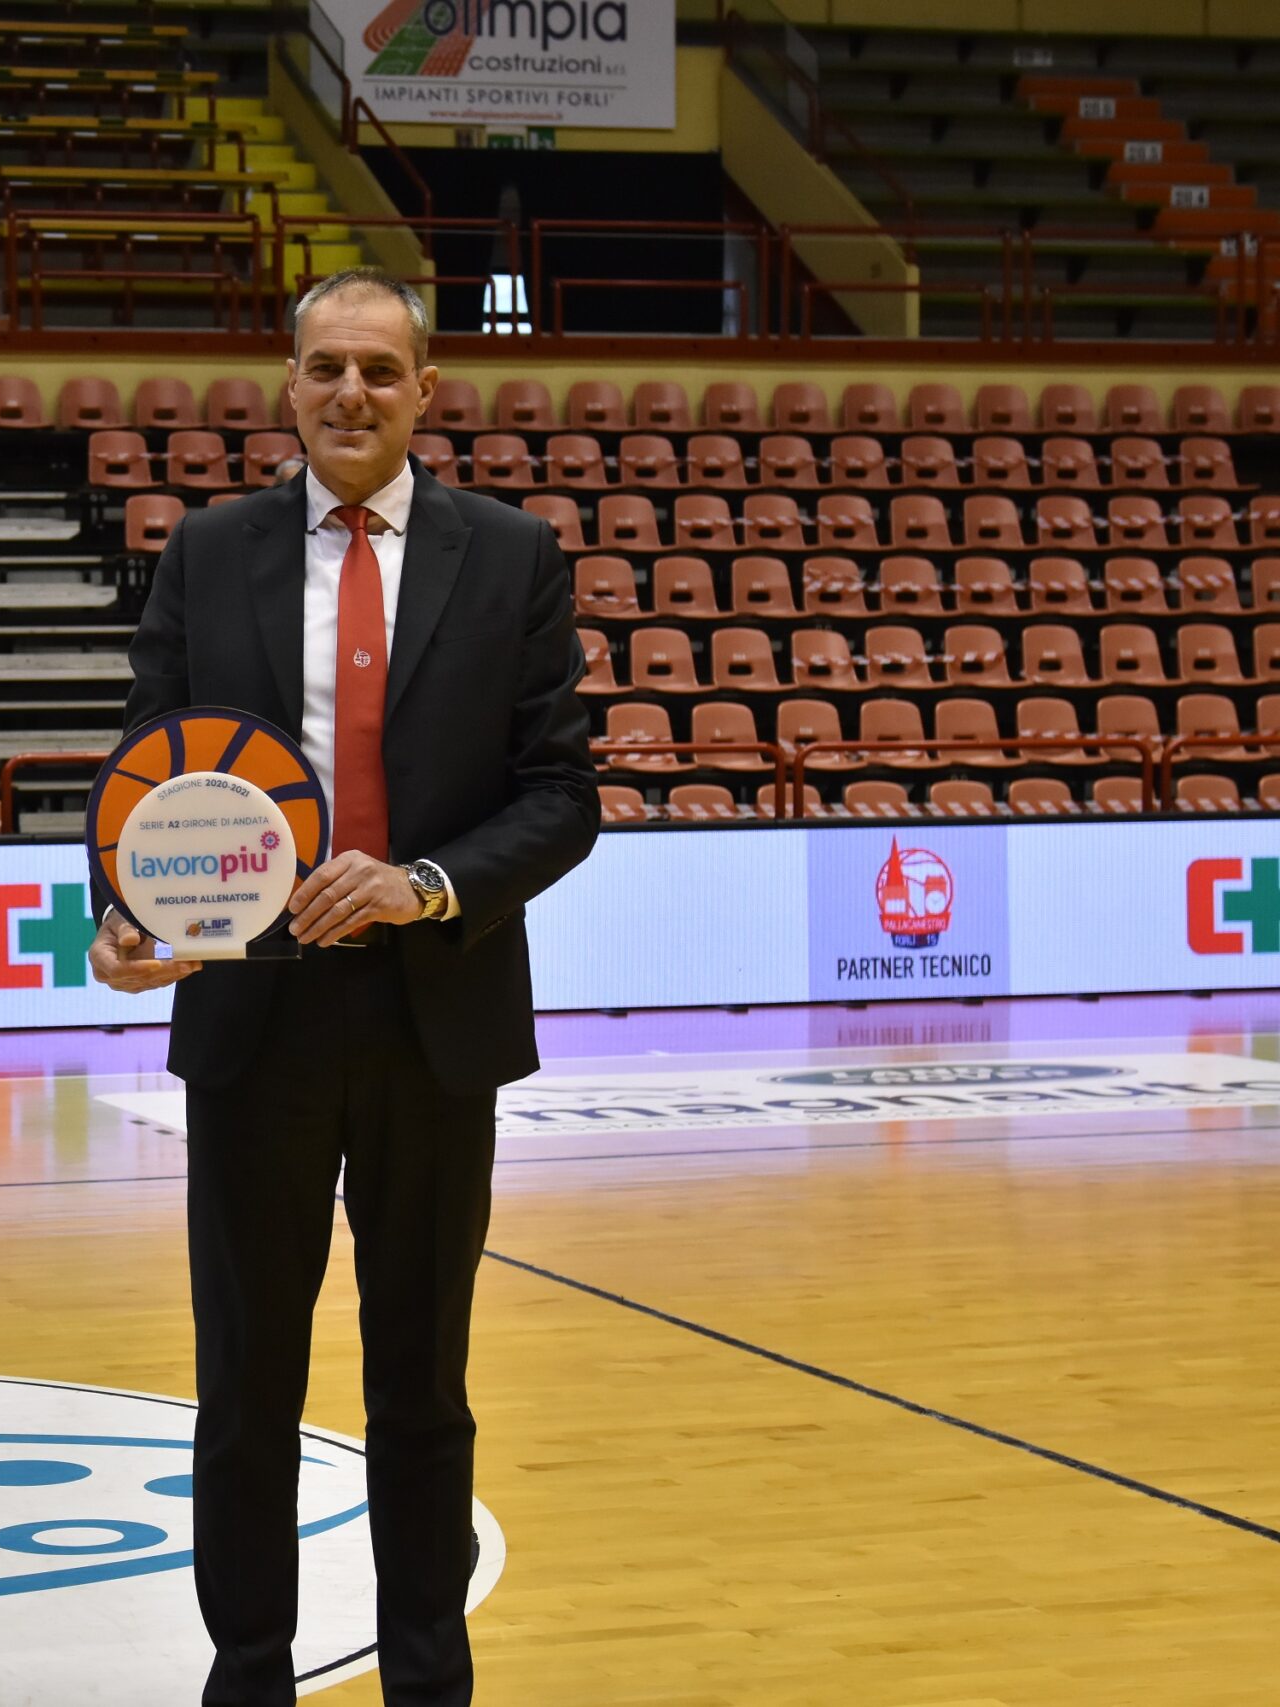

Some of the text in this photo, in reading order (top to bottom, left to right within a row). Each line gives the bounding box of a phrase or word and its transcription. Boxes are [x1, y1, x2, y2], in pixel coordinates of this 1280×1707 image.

[424, 0, 628, 51] olimpia
[468, 53, 602, 76] costruzioni
[374, 86, 458, 103] IMPIANTI
[467, 88, 549, 106] SPORTIVI
[157, 778, 250, 801] STAGIONE 2020-2021
[139, 815, 270, 831] SERIE A2 GIRONE DI ANDATA
[154, 892, 260, 906] MIGLIOR ALLENATORE
[836, 954, 992, 981] PARTNER TECNICO
[495, 1081, 1280, 1122] magnauto
